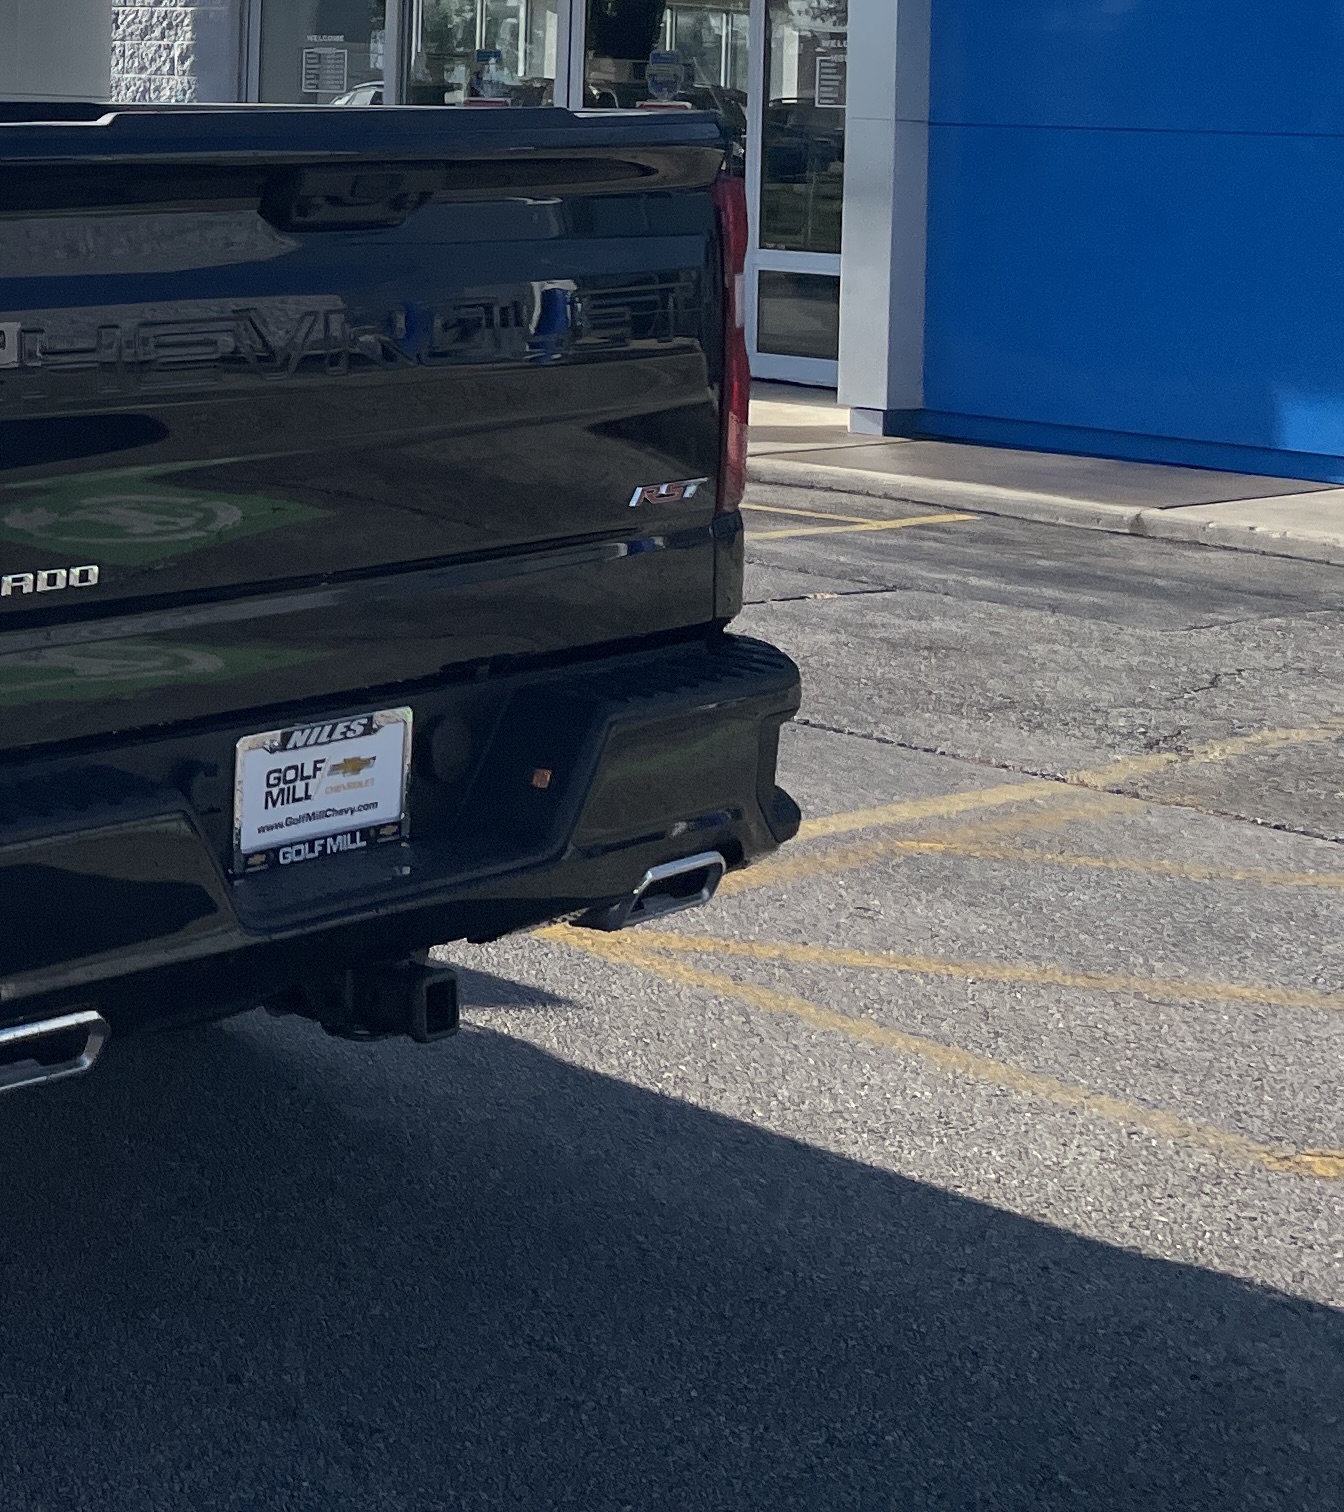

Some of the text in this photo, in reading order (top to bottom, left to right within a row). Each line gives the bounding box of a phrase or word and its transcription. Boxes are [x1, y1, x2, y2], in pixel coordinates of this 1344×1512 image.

[628, 476, 709, 507] RST
[287, 719, 368, 749] NILES
[266, 758, 326, 788] GOLF
[325, 778, 374, 794] CHEVROLET
[265, 783, 312, 810] MILL
[258, 802, 378, 833] www.GolfMillChevy.com
[279, 840, 323, 864] GOLF
[327, 832, 367, 854] MILL
